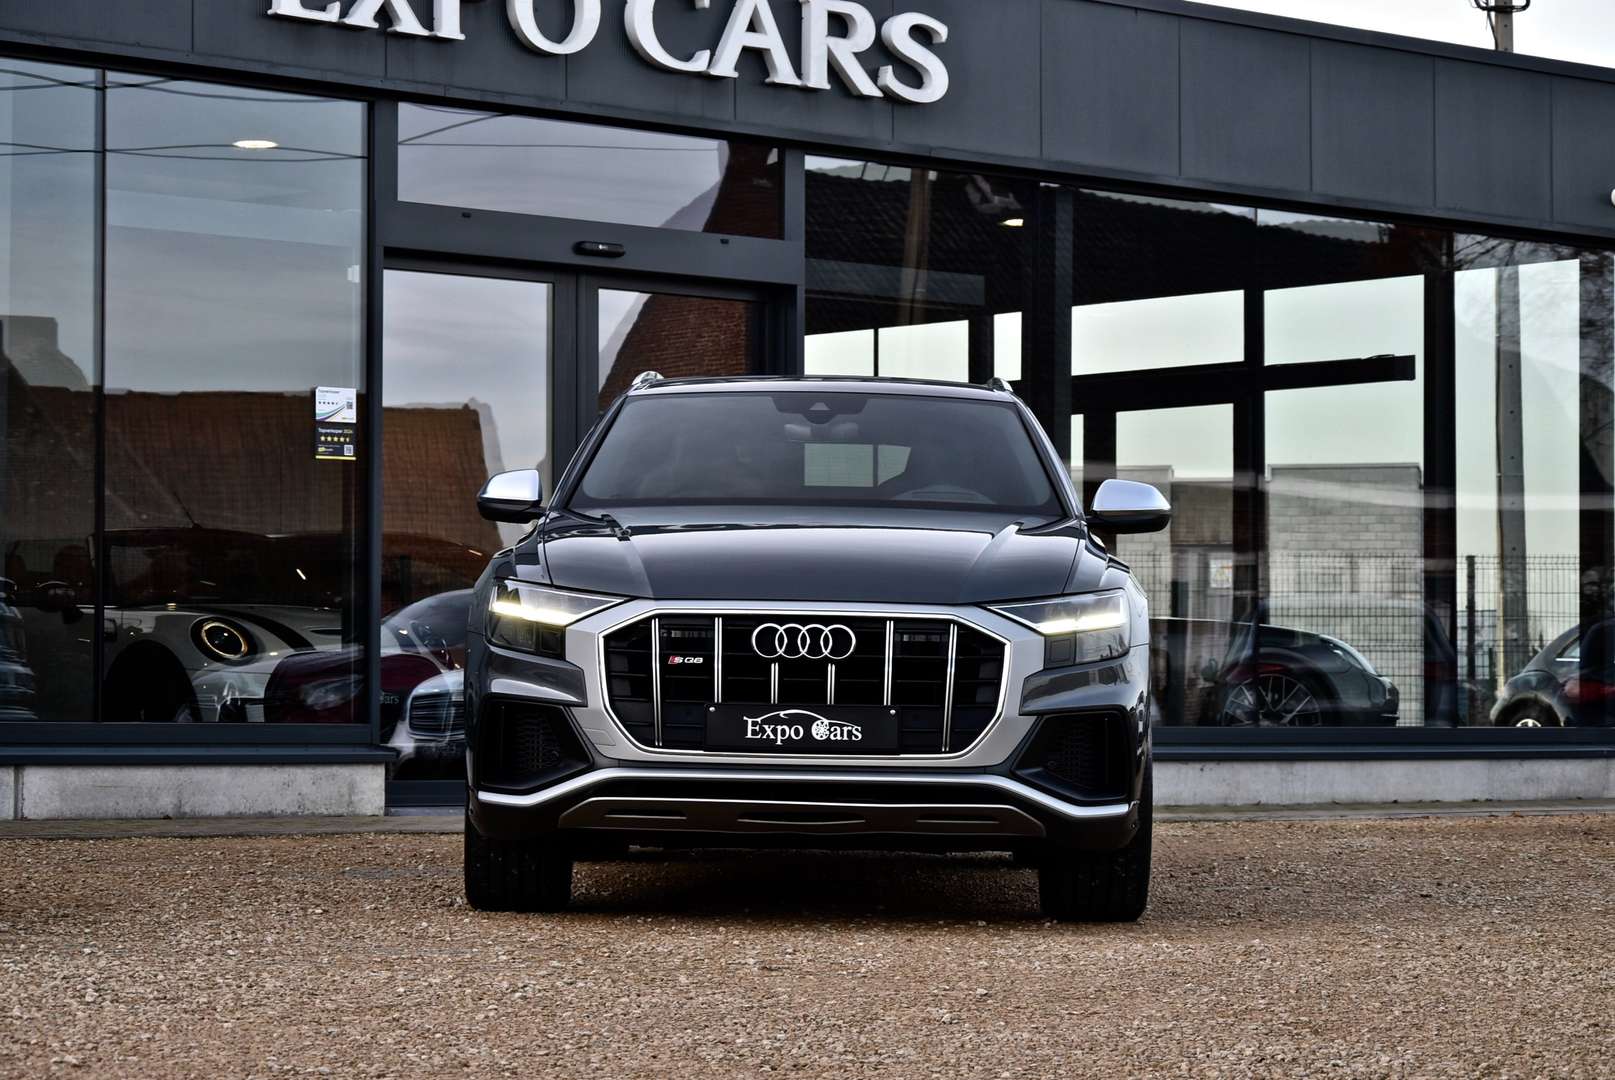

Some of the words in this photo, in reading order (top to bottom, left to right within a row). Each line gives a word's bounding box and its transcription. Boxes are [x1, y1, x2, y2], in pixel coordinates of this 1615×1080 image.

[624, 0, 950, 104] CARS
[743, 716, 804, 745] Expo
[811, 719, 863, 741] Cars
